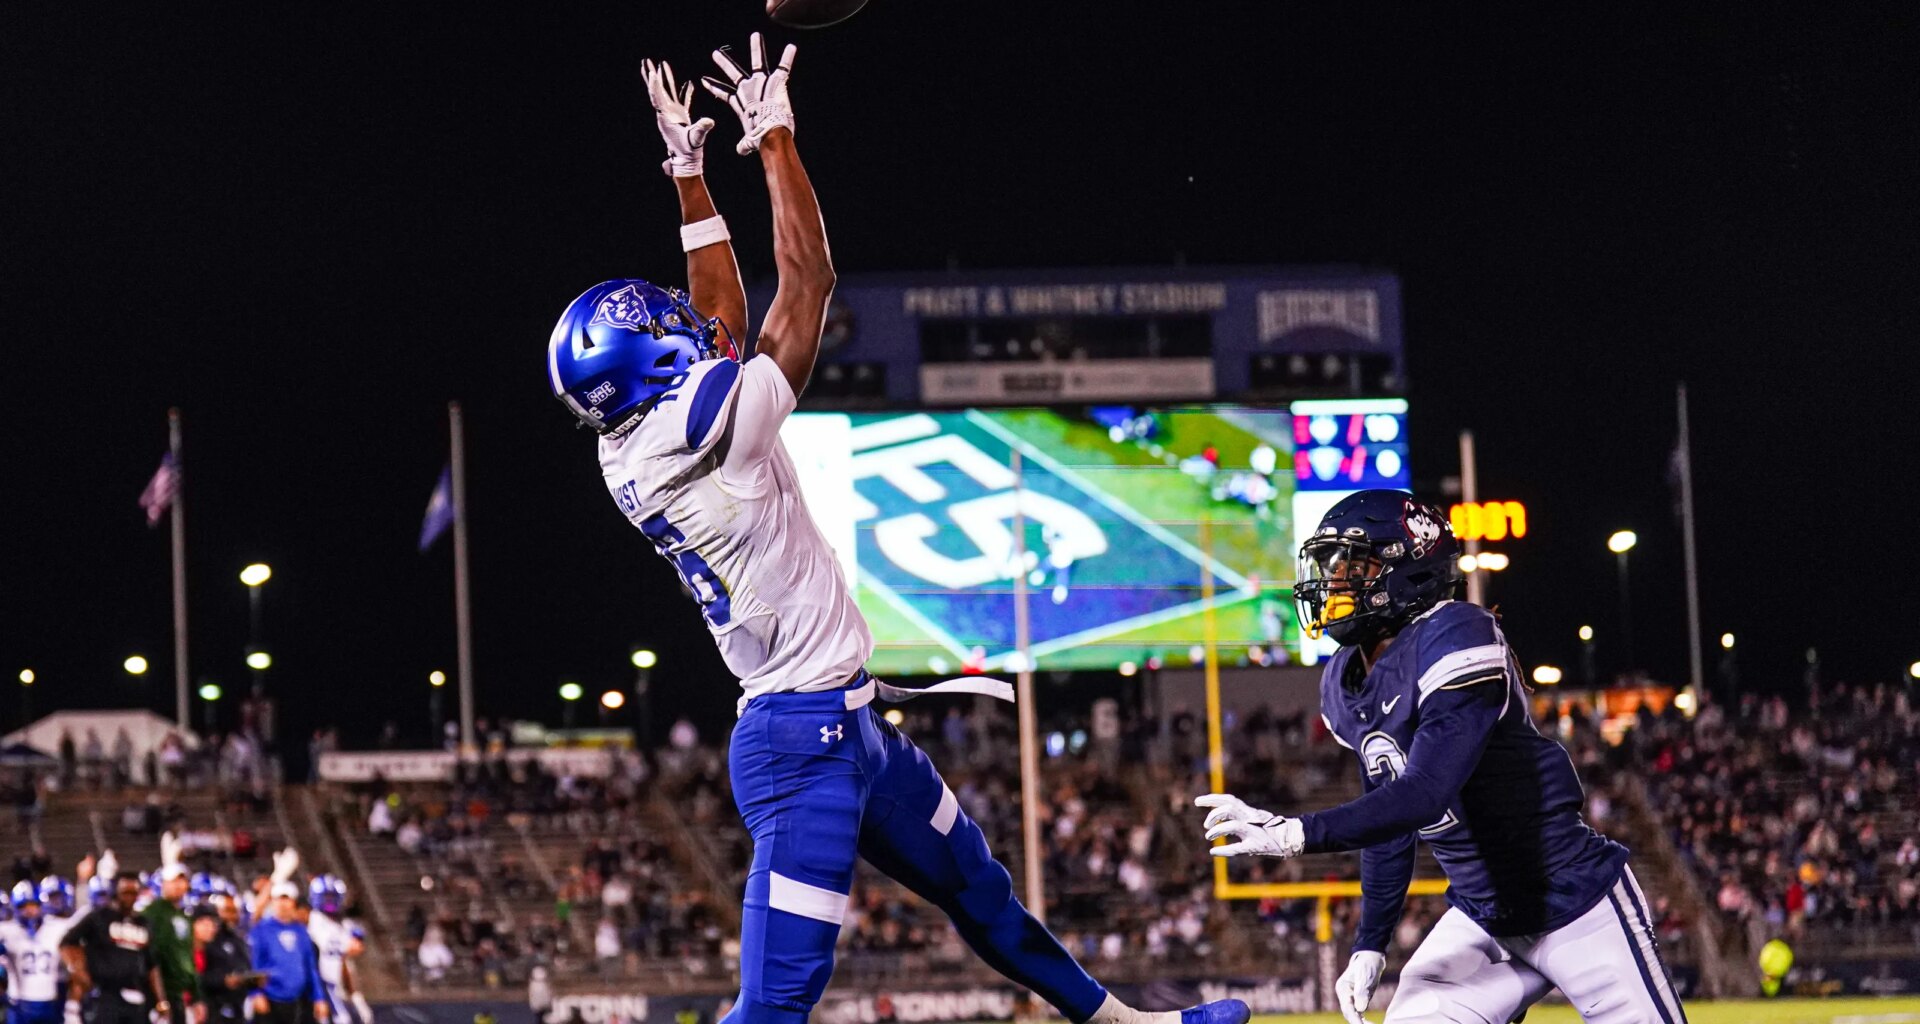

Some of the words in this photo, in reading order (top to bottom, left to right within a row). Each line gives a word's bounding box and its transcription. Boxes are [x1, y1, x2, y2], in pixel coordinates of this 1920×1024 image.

[1120, 282, 1226, 313] STADIUM
[587, 381, 616, 406] SBC
[588, 406, 604, 420] 6
